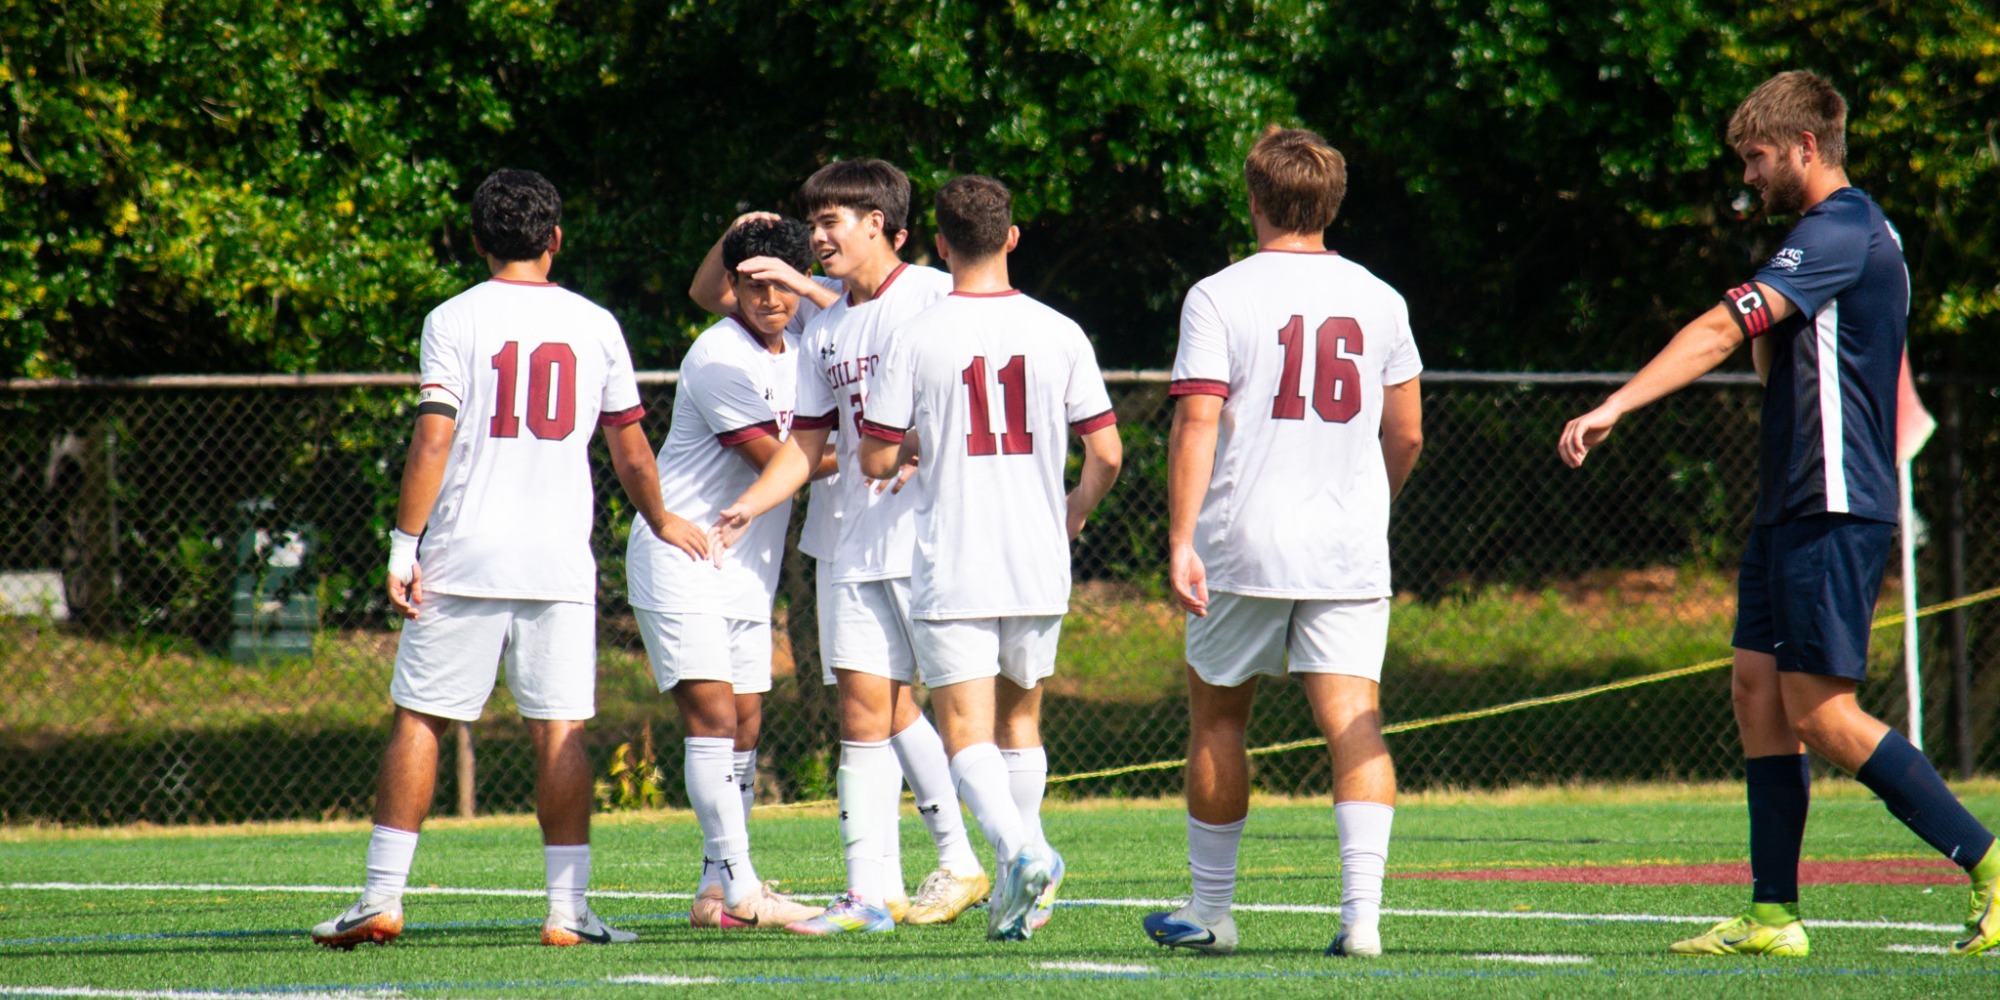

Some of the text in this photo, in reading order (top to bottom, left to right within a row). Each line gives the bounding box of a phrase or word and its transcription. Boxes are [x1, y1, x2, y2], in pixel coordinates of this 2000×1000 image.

[1736, 291, 1762, 315] C
[490, 340, 576, 441] 10
[962, 355, 1033, 456] 11
[1271, 314, 1364, 424] 16
